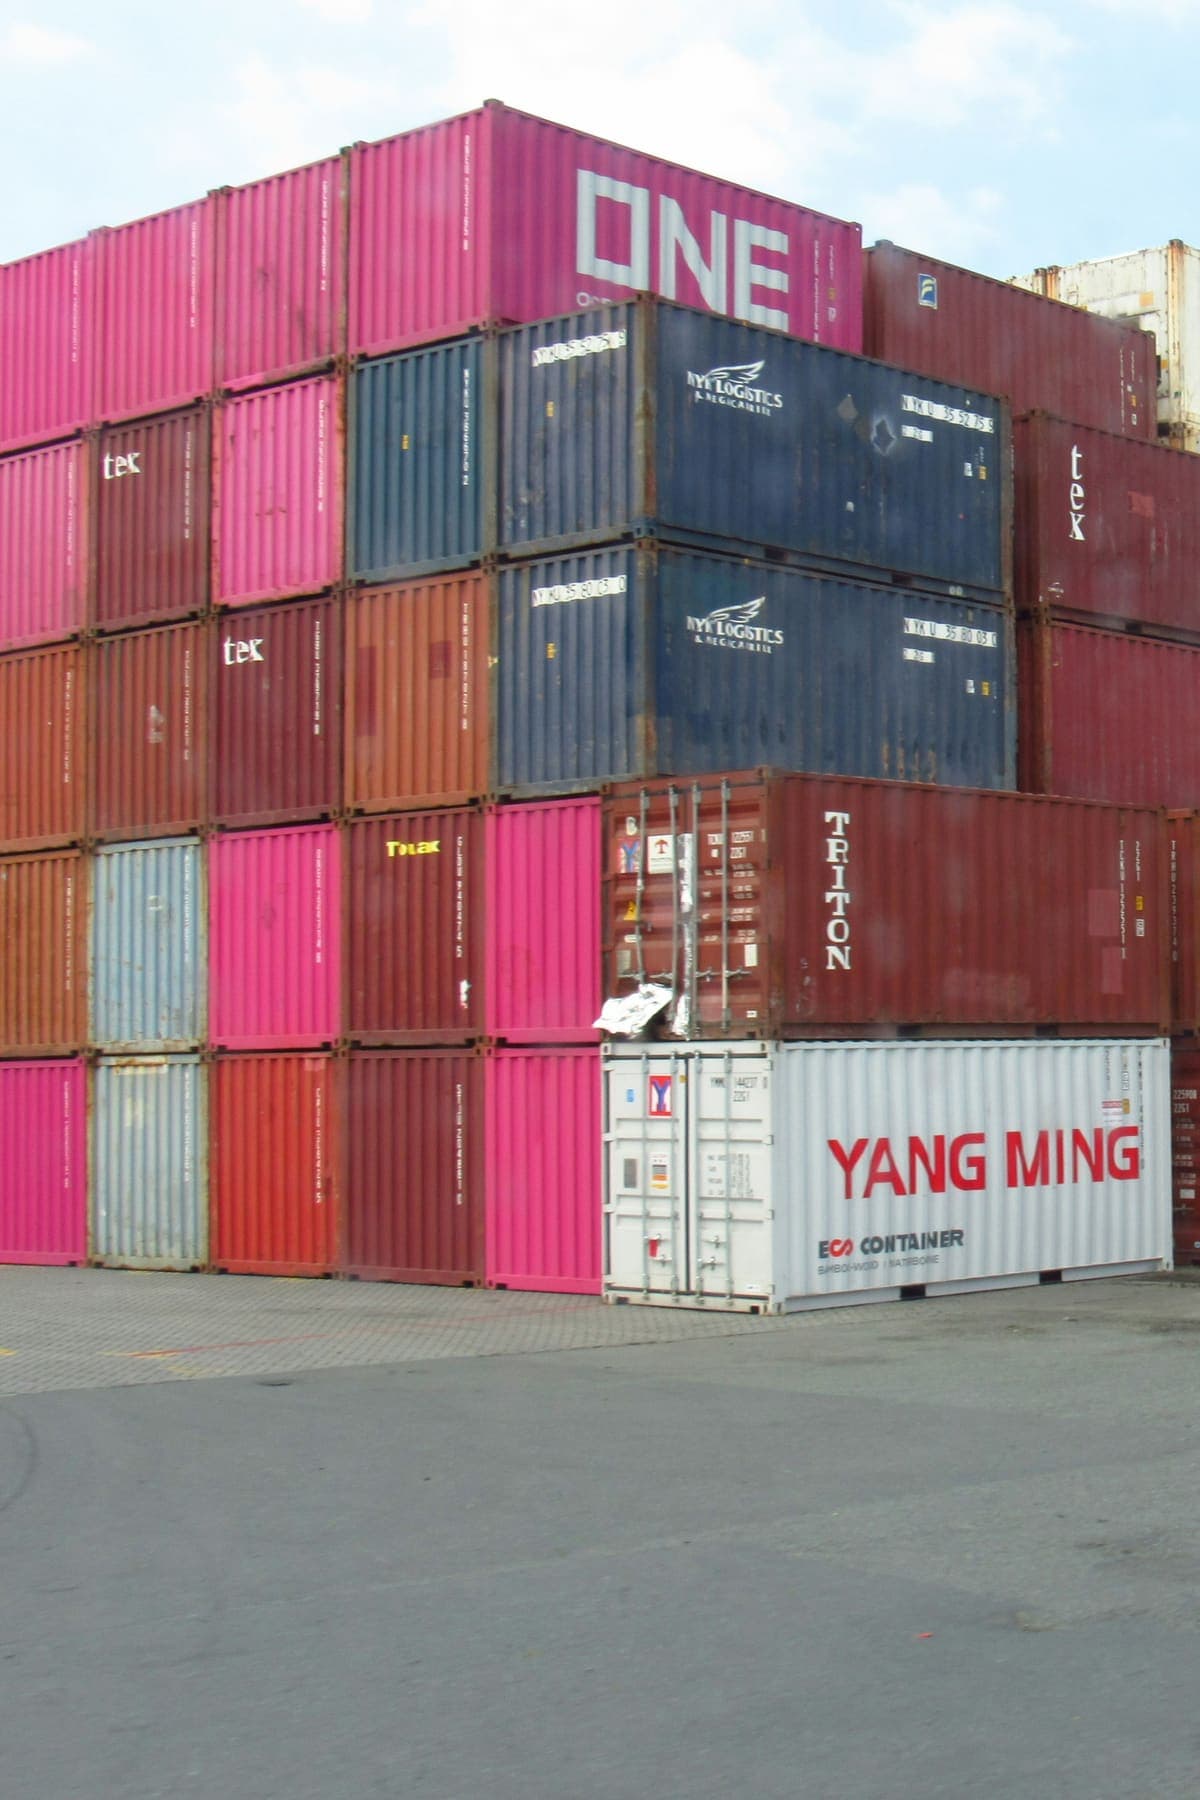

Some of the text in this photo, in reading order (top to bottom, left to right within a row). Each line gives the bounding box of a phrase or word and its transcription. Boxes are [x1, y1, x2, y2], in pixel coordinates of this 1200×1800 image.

[577, 169, 789, 333] ONE
[716, 380, 783, 408] LOGISTICS
[104, 453, 141, 479] tex
[1069, 444, 1086, 541] tex
[717, 622, 784, 645] LOGISTICS
[224, 637, 264, 665] tex
[824, 811, 852, 970] TRITON
[827, 1132, 986, 1199] YANG
[1005, 1125, 1139, 1189] MING
[860, 1229, 964, 1255] CONTAINER
